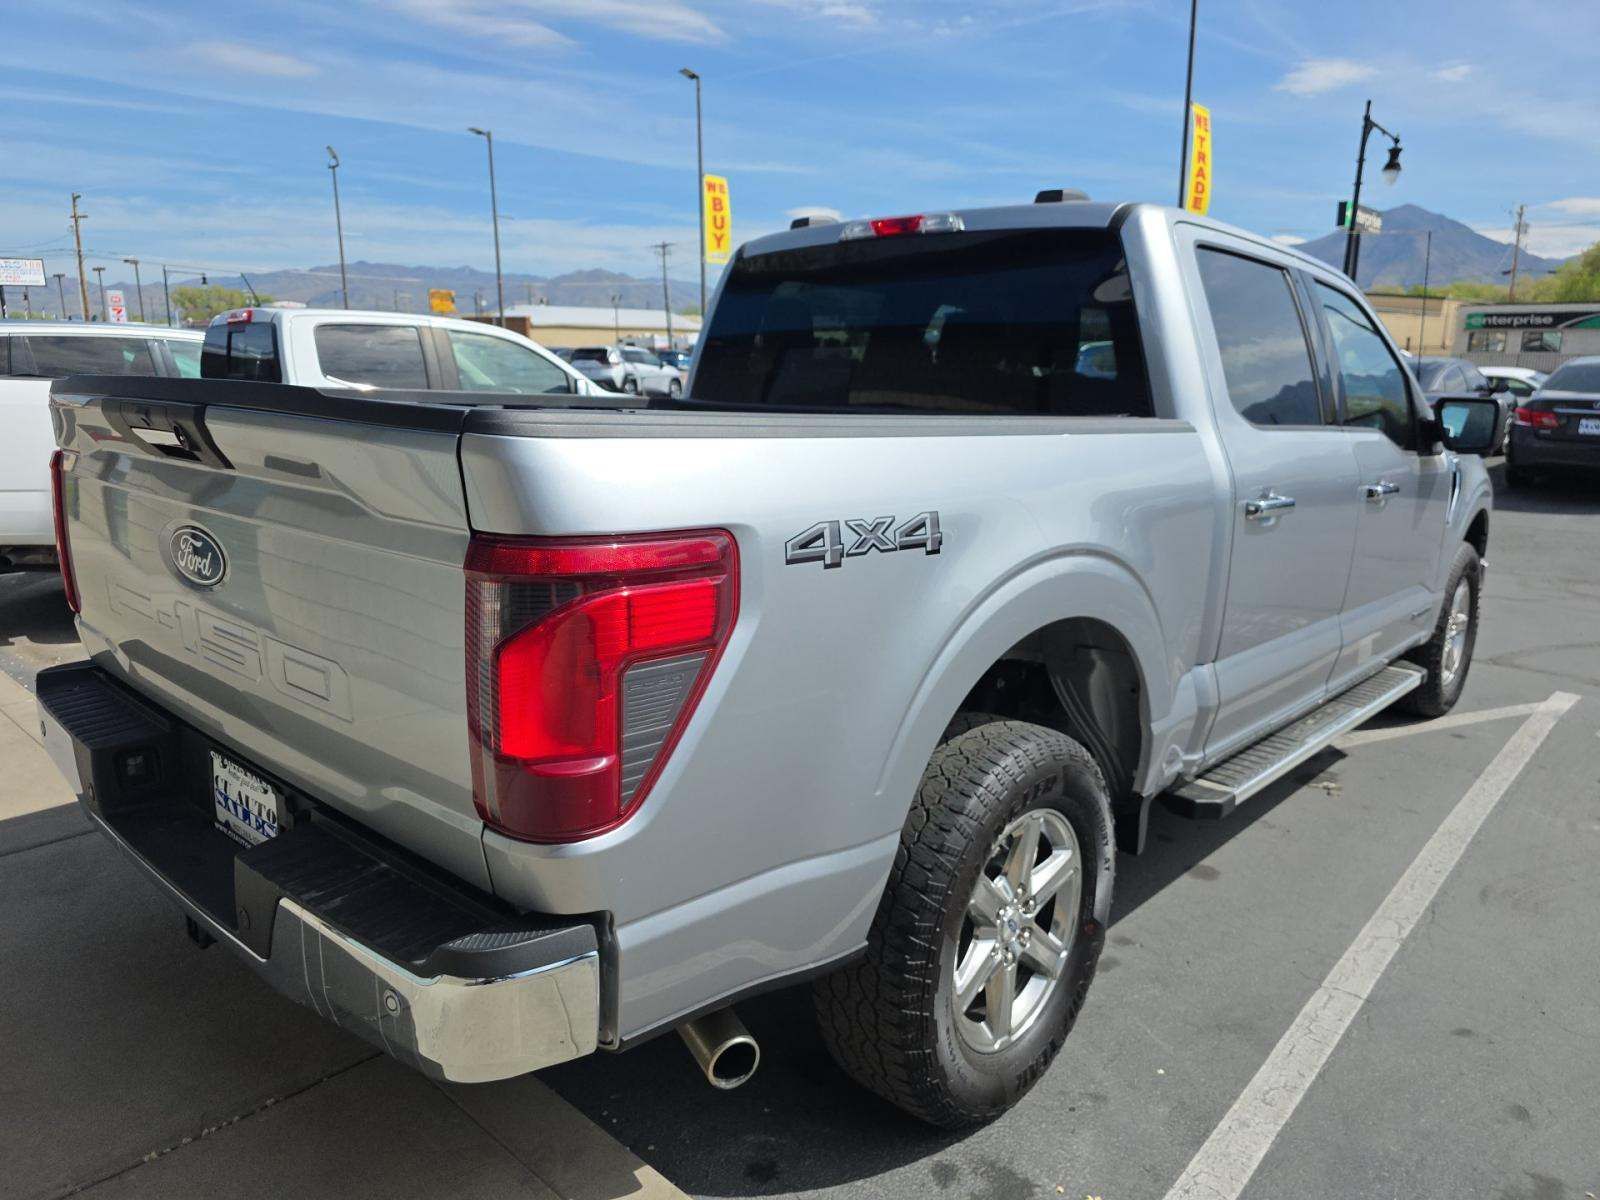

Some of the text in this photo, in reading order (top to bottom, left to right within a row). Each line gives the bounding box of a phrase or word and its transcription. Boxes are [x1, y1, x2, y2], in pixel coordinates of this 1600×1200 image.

[705, 181, 727, 194] WE
[1192, 135, 1206, 210] TRADE
[712, 197, 725, 248] BUY
[1469, 314, 1553, 326] enterprise
[178, 535, 212, 577] Ford
[105, 574, 353, 724] F-150
